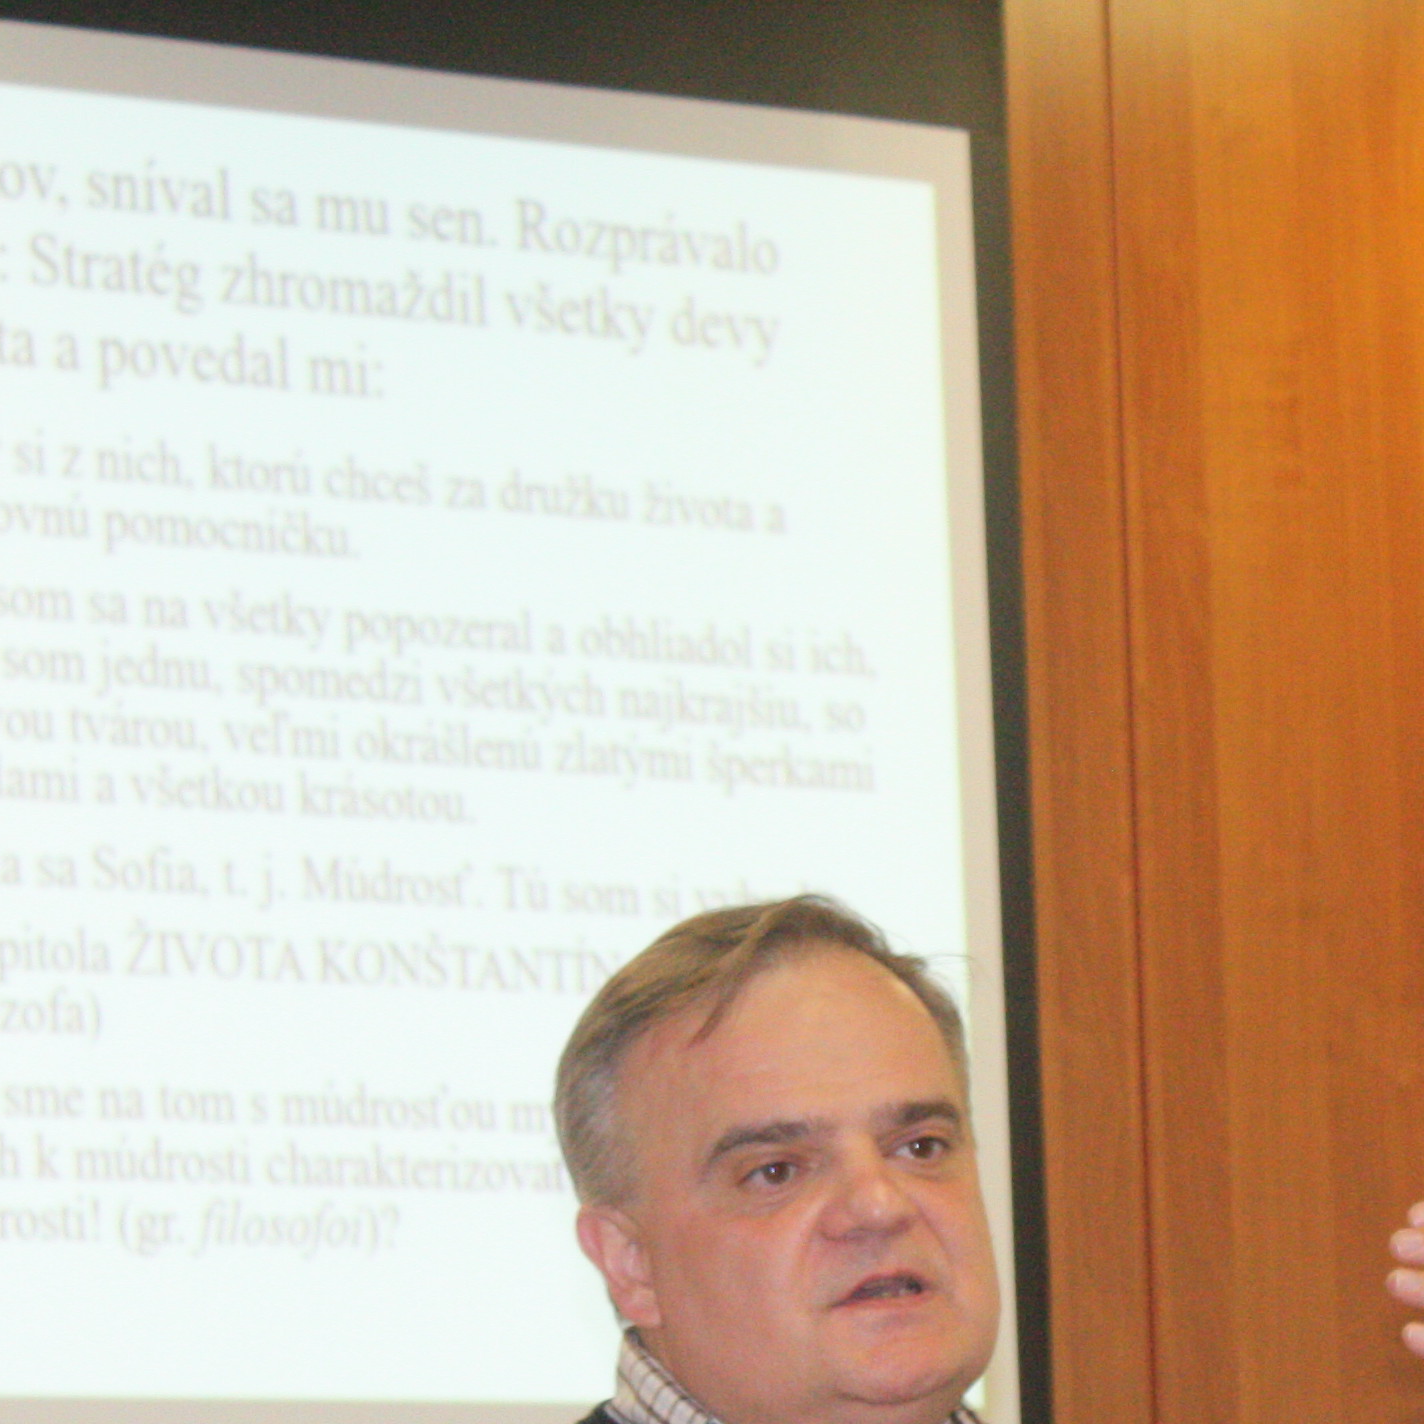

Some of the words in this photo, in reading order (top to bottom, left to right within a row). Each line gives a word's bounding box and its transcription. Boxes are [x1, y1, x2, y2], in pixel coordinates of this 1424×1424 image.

[86, 156, 229, 222] sníval
[249, 185, 298, 229] sa
[317, 191, 389, 236] mu
[406, 201, 496, 248] sen.
[516, 198, 778, 276] Rozprávalo
[29, 233, 201, 313] Stratég
[219, 251, 487, 328] zhromaždil
[505, 280, 653, 356] všetky
[671, 297, 778, 368] devy
[53, 330, 79, 370] a
[97, 332, 288, 391] povedal
[308, 342, 384, 398] mi:
[14, 427, 44, 478] si
[61, 443, 81, 478] z
[95, 433, 193, 492] nich,
[207, 442, 310, 496] ktorú
[324, 455, 430, 506] chceš
[445, 474, 485, 510] za
[498, 468, 629, 520] družku
[642, 479, 753, 533] života
[765, 502, 786, 535] a
[87, 586, 126, 625] sa
[142, 593, 188, 628] na
[201, 590, 329, 651] všetky
[343, 606, 531, 656] popozeral
[546, 620, 565, 655] a
[765, 625, 793, 671] si
[807, 627, 875, 679] ich,
[1, 646, 84, 684] som
[95, 638, 220, 696] jednu,
[236, 658, 421, 707] spomedzi
[437, 665, 606, 726] všetkých
[824, 700, 866, 732] so
[67, 700, 207, 753] tvárou,
[222, 710, 339, 760] veľmi
[354, 718, 541, 771] okrášlenú
[555, 727, 691, 789] zlatými
[707, 741, 875, 797] šperkami
[93, 770, 115, 803] a
[128, 763, 284, 812] všetkou
[298, 769, 475, 824] krásotou.
[35, 852, 76, 889] sa
[90, 843, 207, 898] Sofia,
[221, 856, 246, 897] t.
[258, 849, 285, 912] j.
[493, 863, 549, 913] Tú
[561, 881, 640, 916] som
[651, 871, 680, 918] si
[123, 916, 306, 982] ŽIVOTA
[1, 1081, 83, 1119] sme
[97, 1084, 143, 1120] na
[158, 1082, 235, 1123] tom
[250, 1091, 267, 1124] s
[279, 1077, 495, 1131] múdrosťou
[35, 1132, 57, 1179] k
[74, 1133, 250, 1187] múdrosti
[116, 1203, 184, 1256] (gr.
